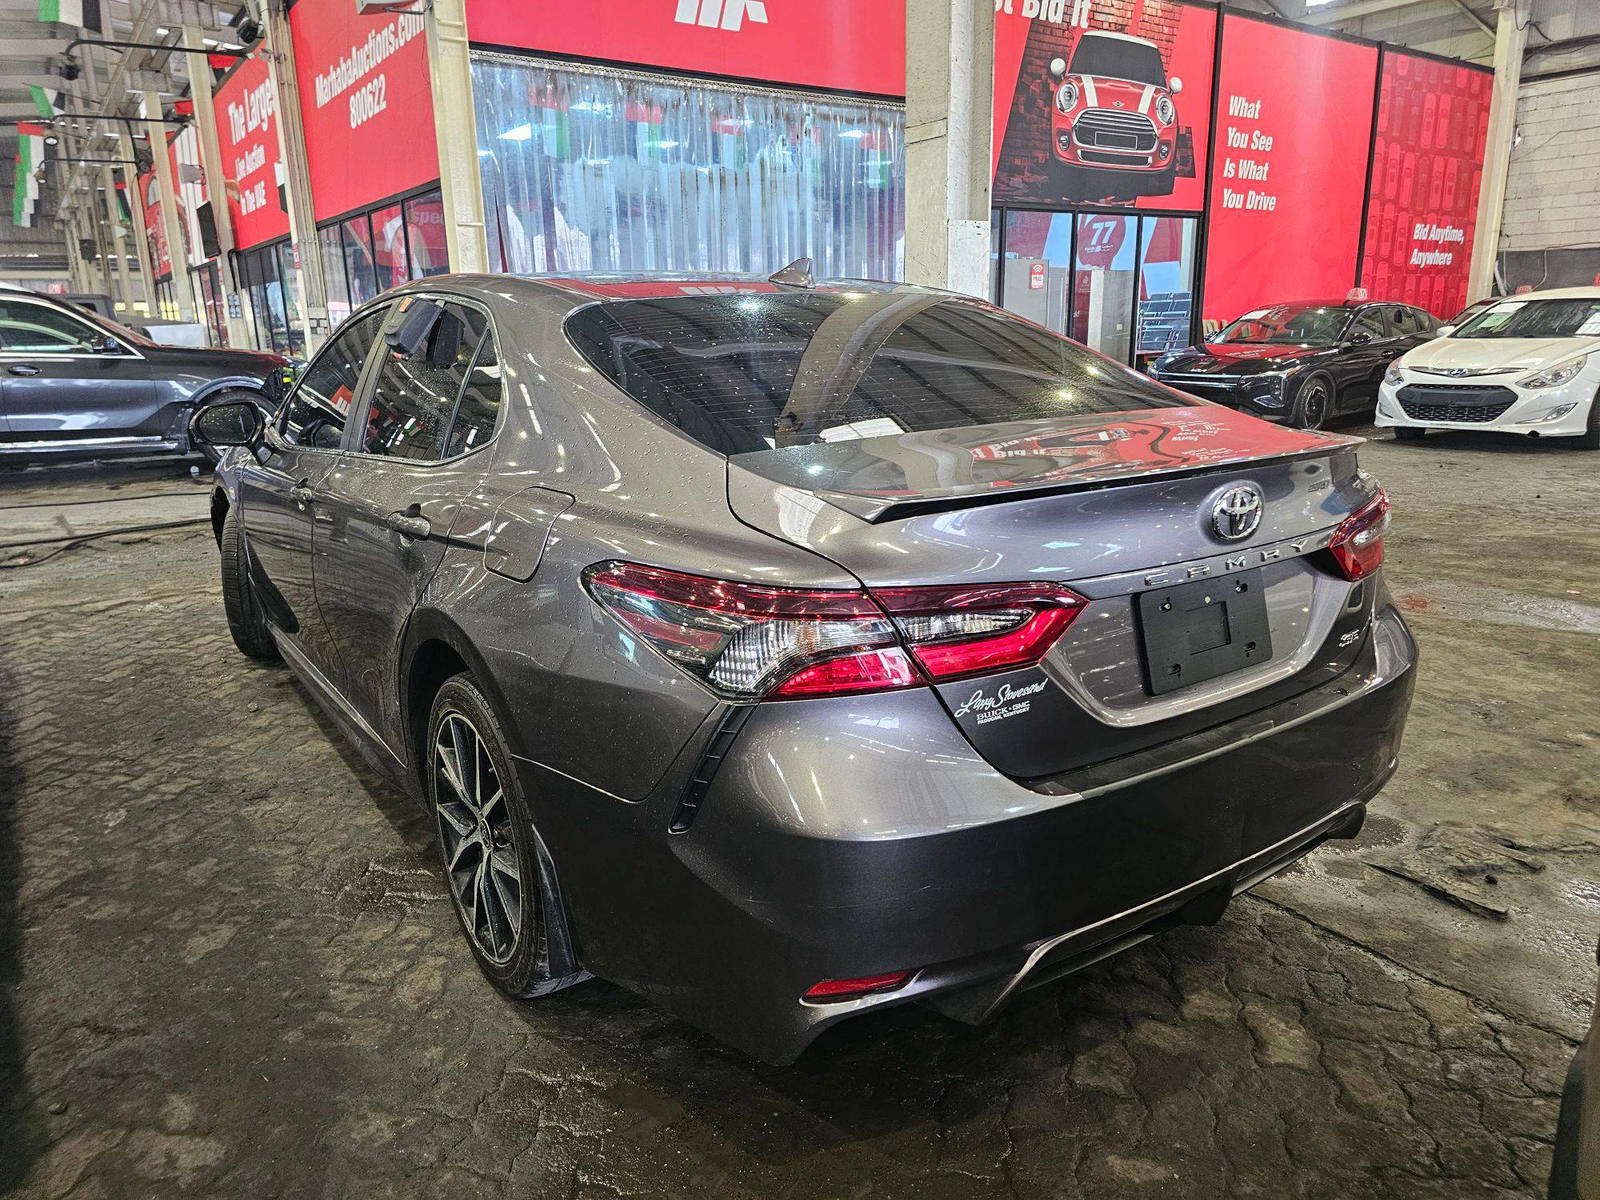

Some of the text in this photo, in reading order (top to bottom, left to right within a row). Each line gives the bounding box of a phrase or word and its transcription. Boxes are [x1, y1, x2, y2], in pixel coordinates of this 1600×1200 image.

[315, 0, 425, 109] MarhabaAuctions.com
[349, 73, 387, 129] 800622
[1228, 95, 1261, 120] What
[228, 101, 247, 146] The
[1227, 126, 1274, 152] You See
[245, 143, 266, 177] Auction
[1223, 157, 1269, 181] Is What
[1222, 188, 1277, 212] You Drive
[412, 210, 443, 226] spe
[1090, 220, 1117, 246] 77
[1413, 223, 1465, 245] Bid Anytime,
[1410, 248, 1453, 268] Anywhere
[1144, 539, 1309, 587] CAMRY
[976, 700, 1031, 721] BUICK GMC
